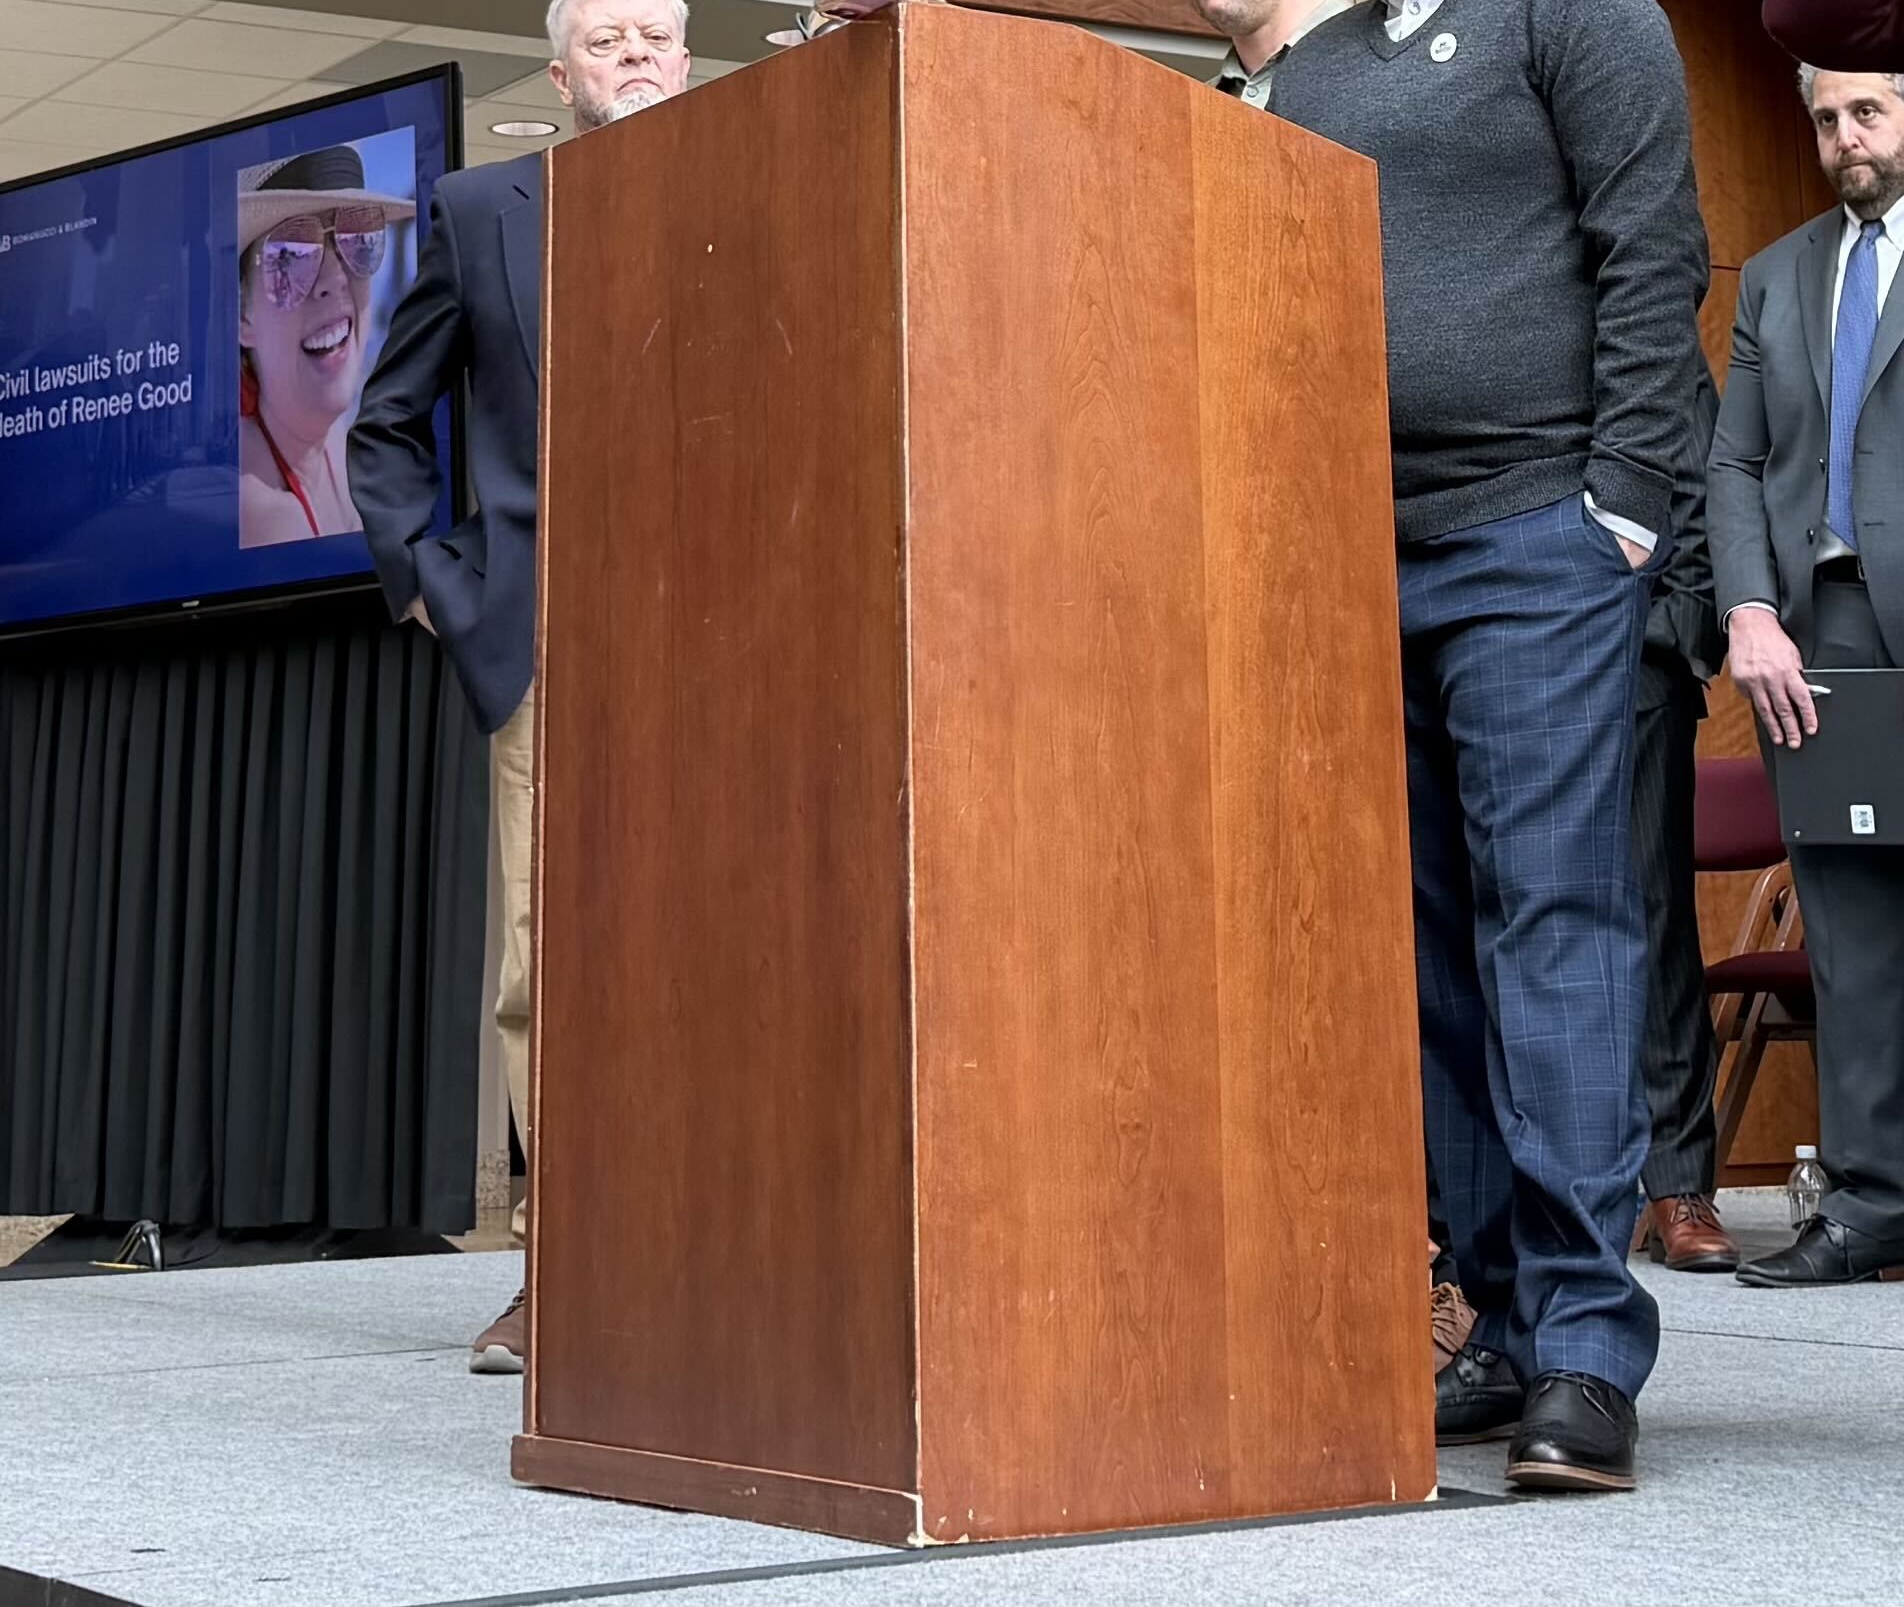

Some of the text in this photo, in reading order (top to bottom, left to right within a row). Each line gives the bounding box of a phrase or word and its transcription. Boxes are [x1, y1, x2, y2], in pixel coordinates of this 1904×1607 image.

[34, 354, 111, 393] lawsuits
[116, 348, 143, 375] for
[148, 340, 180, 368] the
[48, 399, 68, 428] of
[72, 392, 133, 424] Renee
[138, 373, 192, 410] Good
